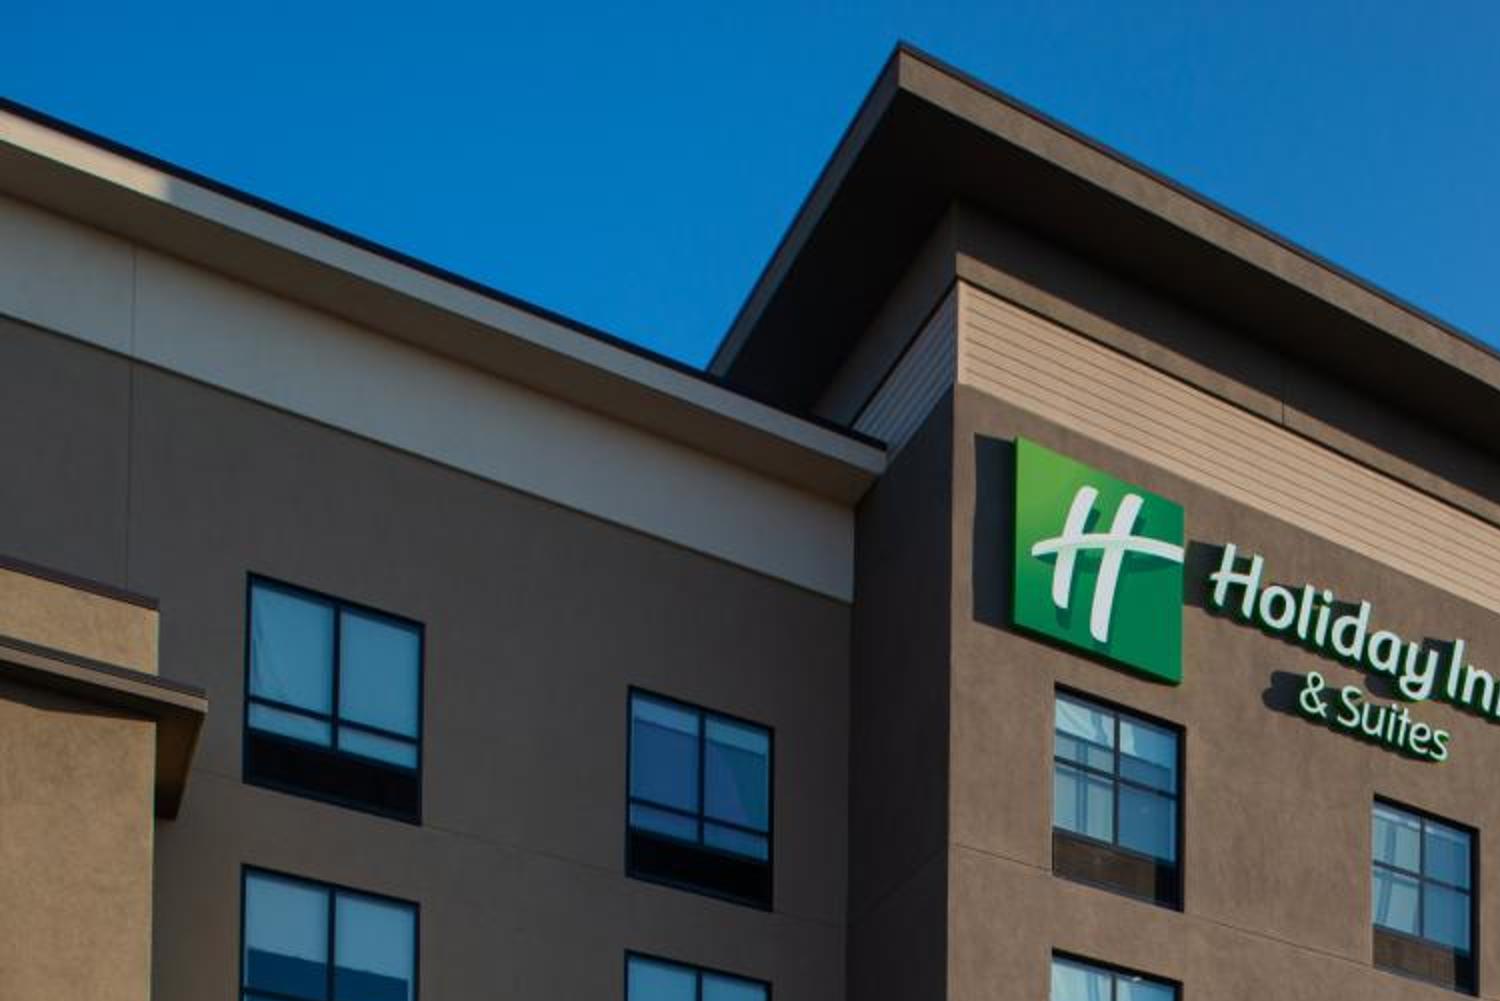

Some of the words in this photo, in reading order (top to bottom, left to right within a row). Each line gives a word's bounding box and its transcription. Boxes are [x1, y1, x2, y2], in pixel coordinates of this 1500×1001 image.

[1031, 485, 1185, 644] H
[1209, 543, 1438, 701] Holiday
[1299, 671, 1328, 715] &
[1336, 684, 1451, 763] Suites
